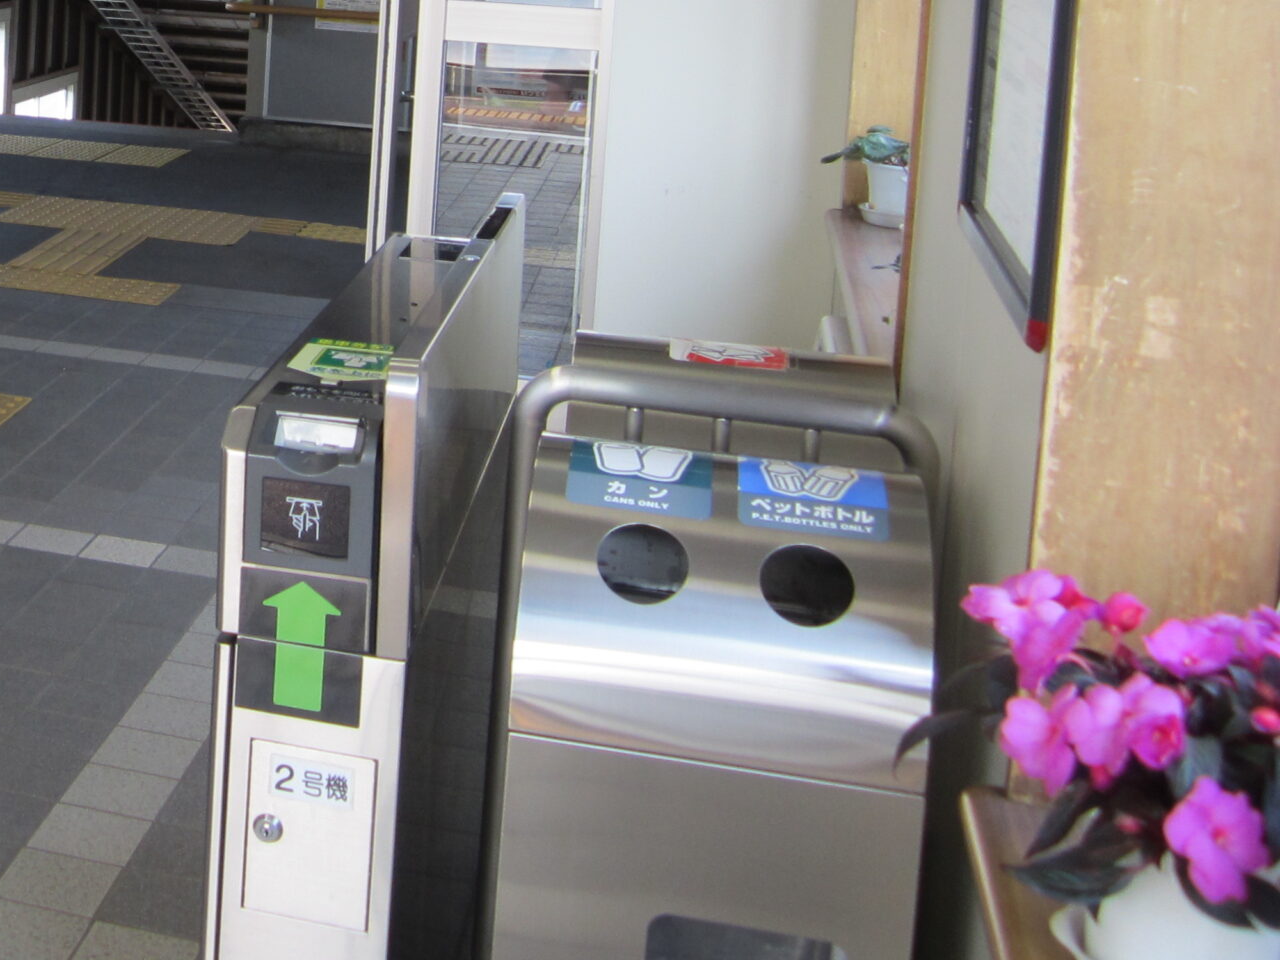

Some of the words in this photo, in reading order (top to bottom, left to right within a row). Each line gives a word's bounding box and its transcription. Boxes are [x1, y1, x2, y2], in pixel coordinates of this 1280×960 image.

[607, 479, 669, 499] カン
[604, 494, 636, 506] CANS
[639, 498, 669, 510] ONLY
[751, 498, 875, 524] ペットボトル
[840, 522, 873, 534] ONLY
[275, 764, 348, 802] 2号機
